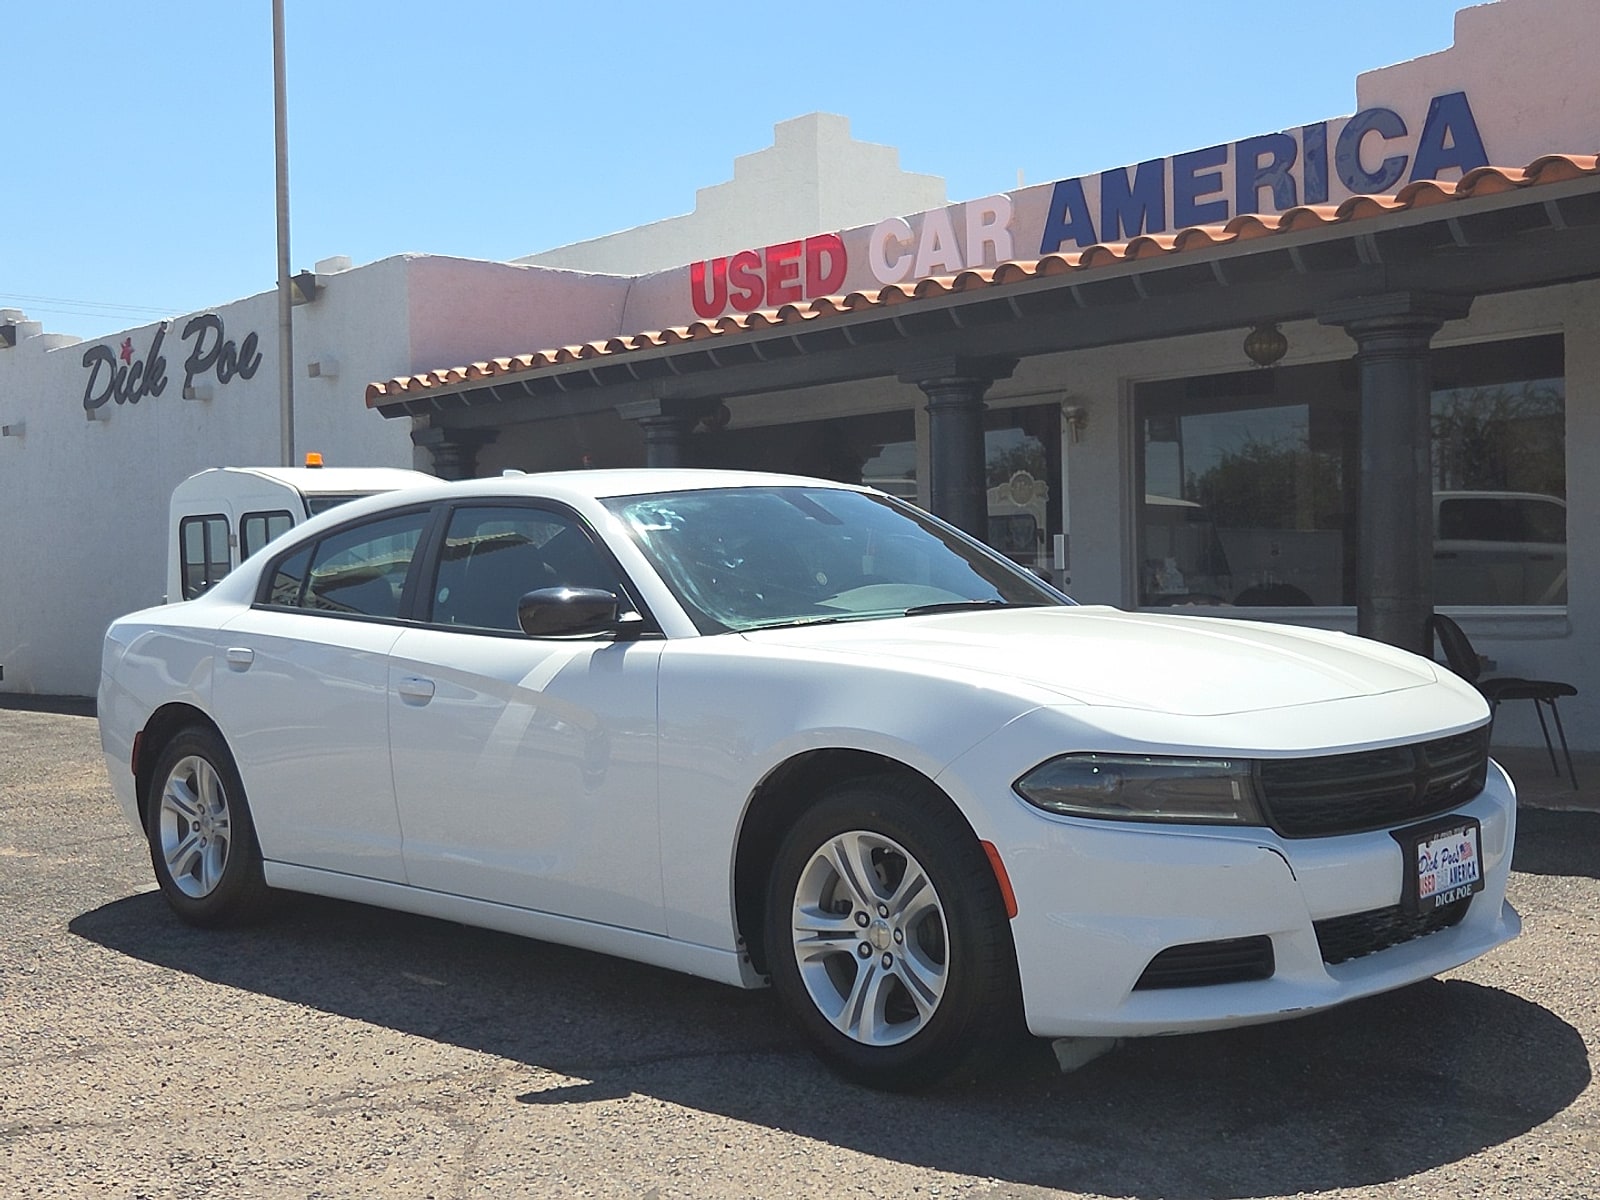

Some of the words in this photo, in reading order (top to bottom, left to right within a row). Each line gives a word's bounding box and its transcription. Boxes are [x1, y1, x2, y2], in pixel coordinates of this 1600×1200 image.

[690, 233, 848, 319] USED
[869, 195, 1014, 285] CAR
[1040, 91, 1490, 255] AMERICA
[83, 321, 168, 410] Dick
[182, 313, 262, 399] Poe
[1435, 889, 1455, 907] DICK
[1456, 884, 1473, 900] POE
[1449, 861, 1476, 885] AMERICA
